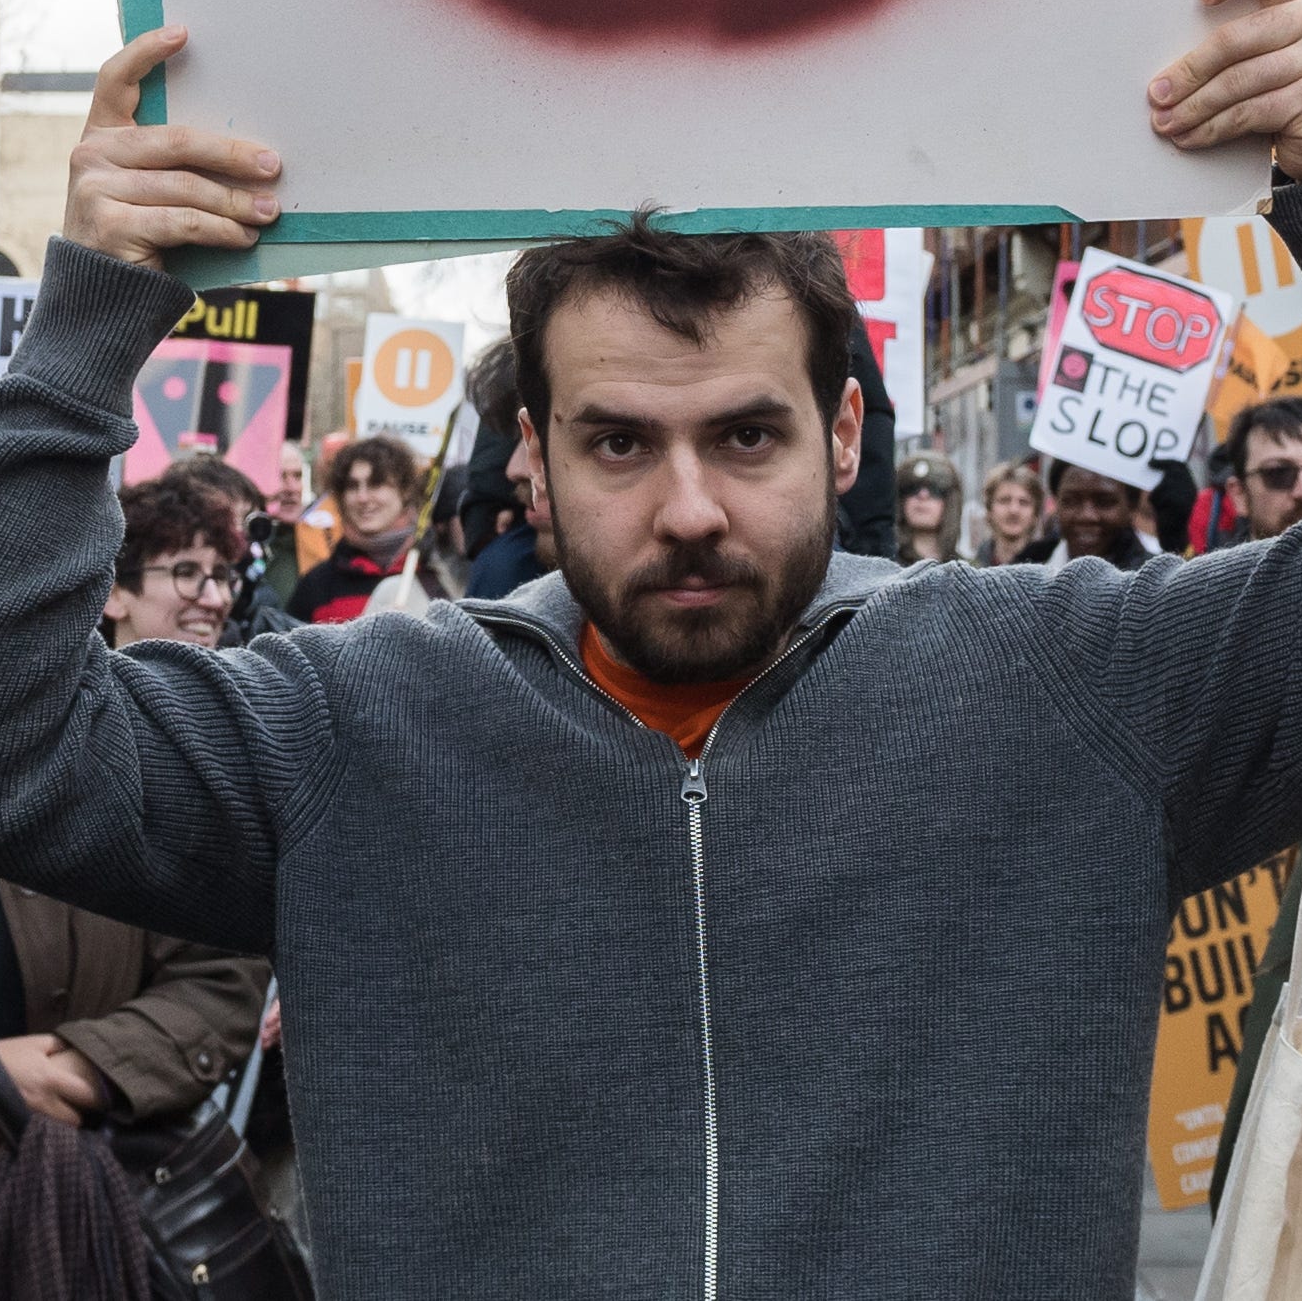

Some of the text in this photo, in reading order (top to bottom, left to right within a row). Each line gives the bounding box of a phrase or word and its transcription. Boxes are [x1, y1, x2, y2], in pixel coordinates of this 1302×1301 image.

[173, 297, 260, 340] Pull
[1084, 286, 1210, 353] STOP
[1092, 359, 1177, 416] THE
[1050, 396, 1180, 464] SLOP
[1168, 856, 1291, 946] ON'T
[1165, 927, 1271, 1014] BUI
[1207, 1006, 1248, 1073] A
